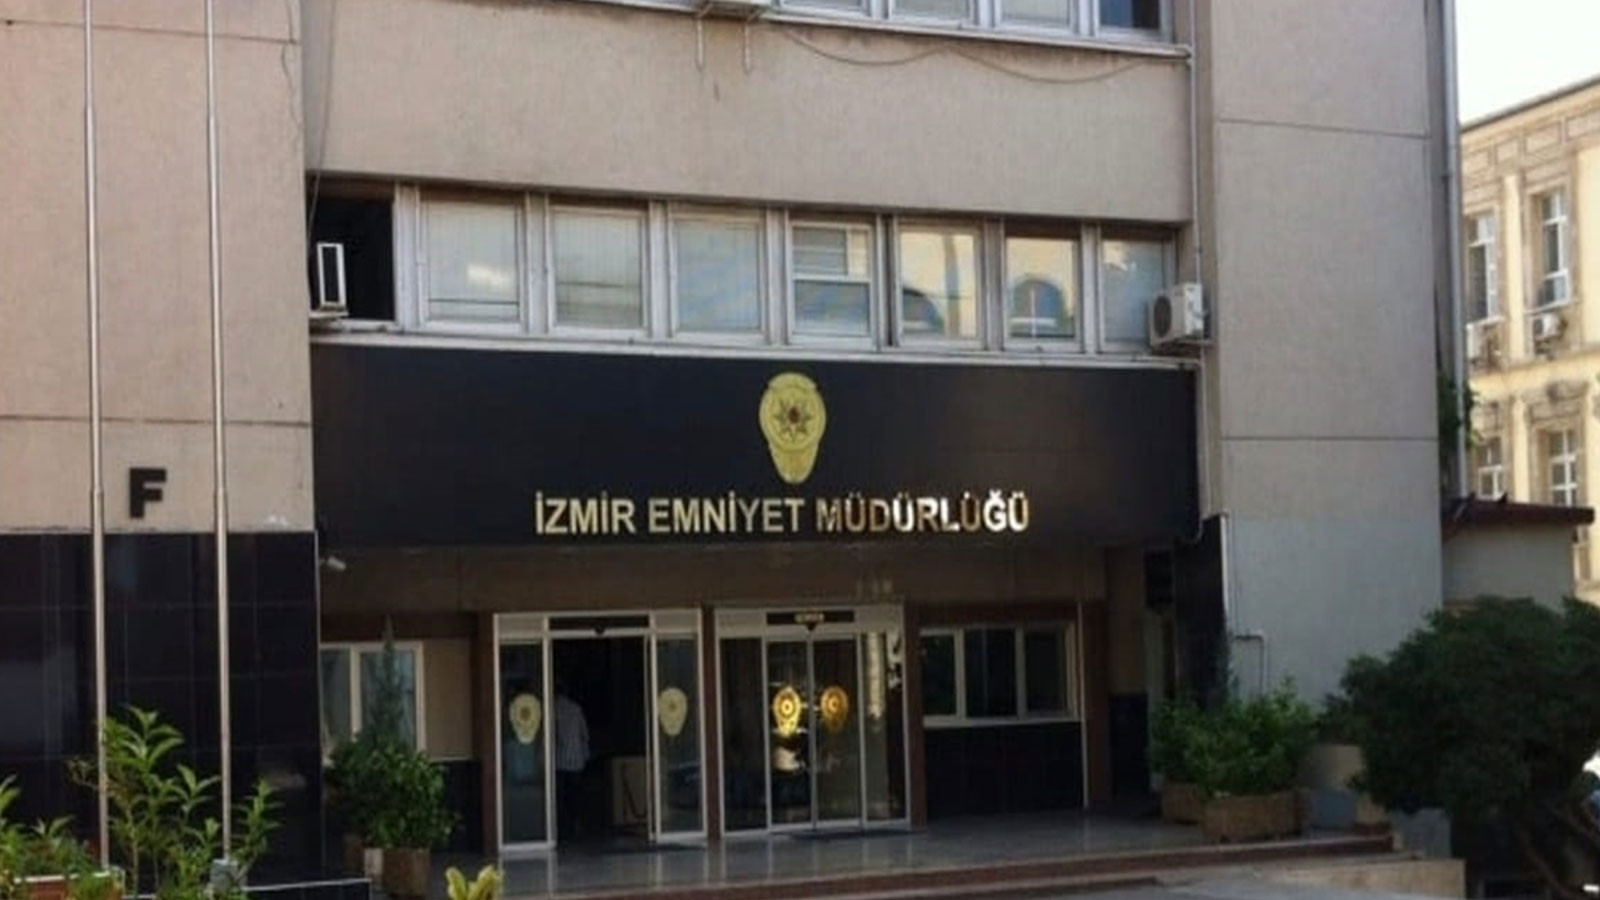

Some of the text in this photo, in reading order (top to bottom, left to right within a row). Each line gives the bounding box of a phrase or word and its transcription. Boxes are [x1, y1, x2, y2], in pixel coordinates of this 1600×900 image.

[129, 467, 167, 519] F
[535, 489, 1030, 535] İZMİR EMNİYET MÜDÜRLÜĞÜ
